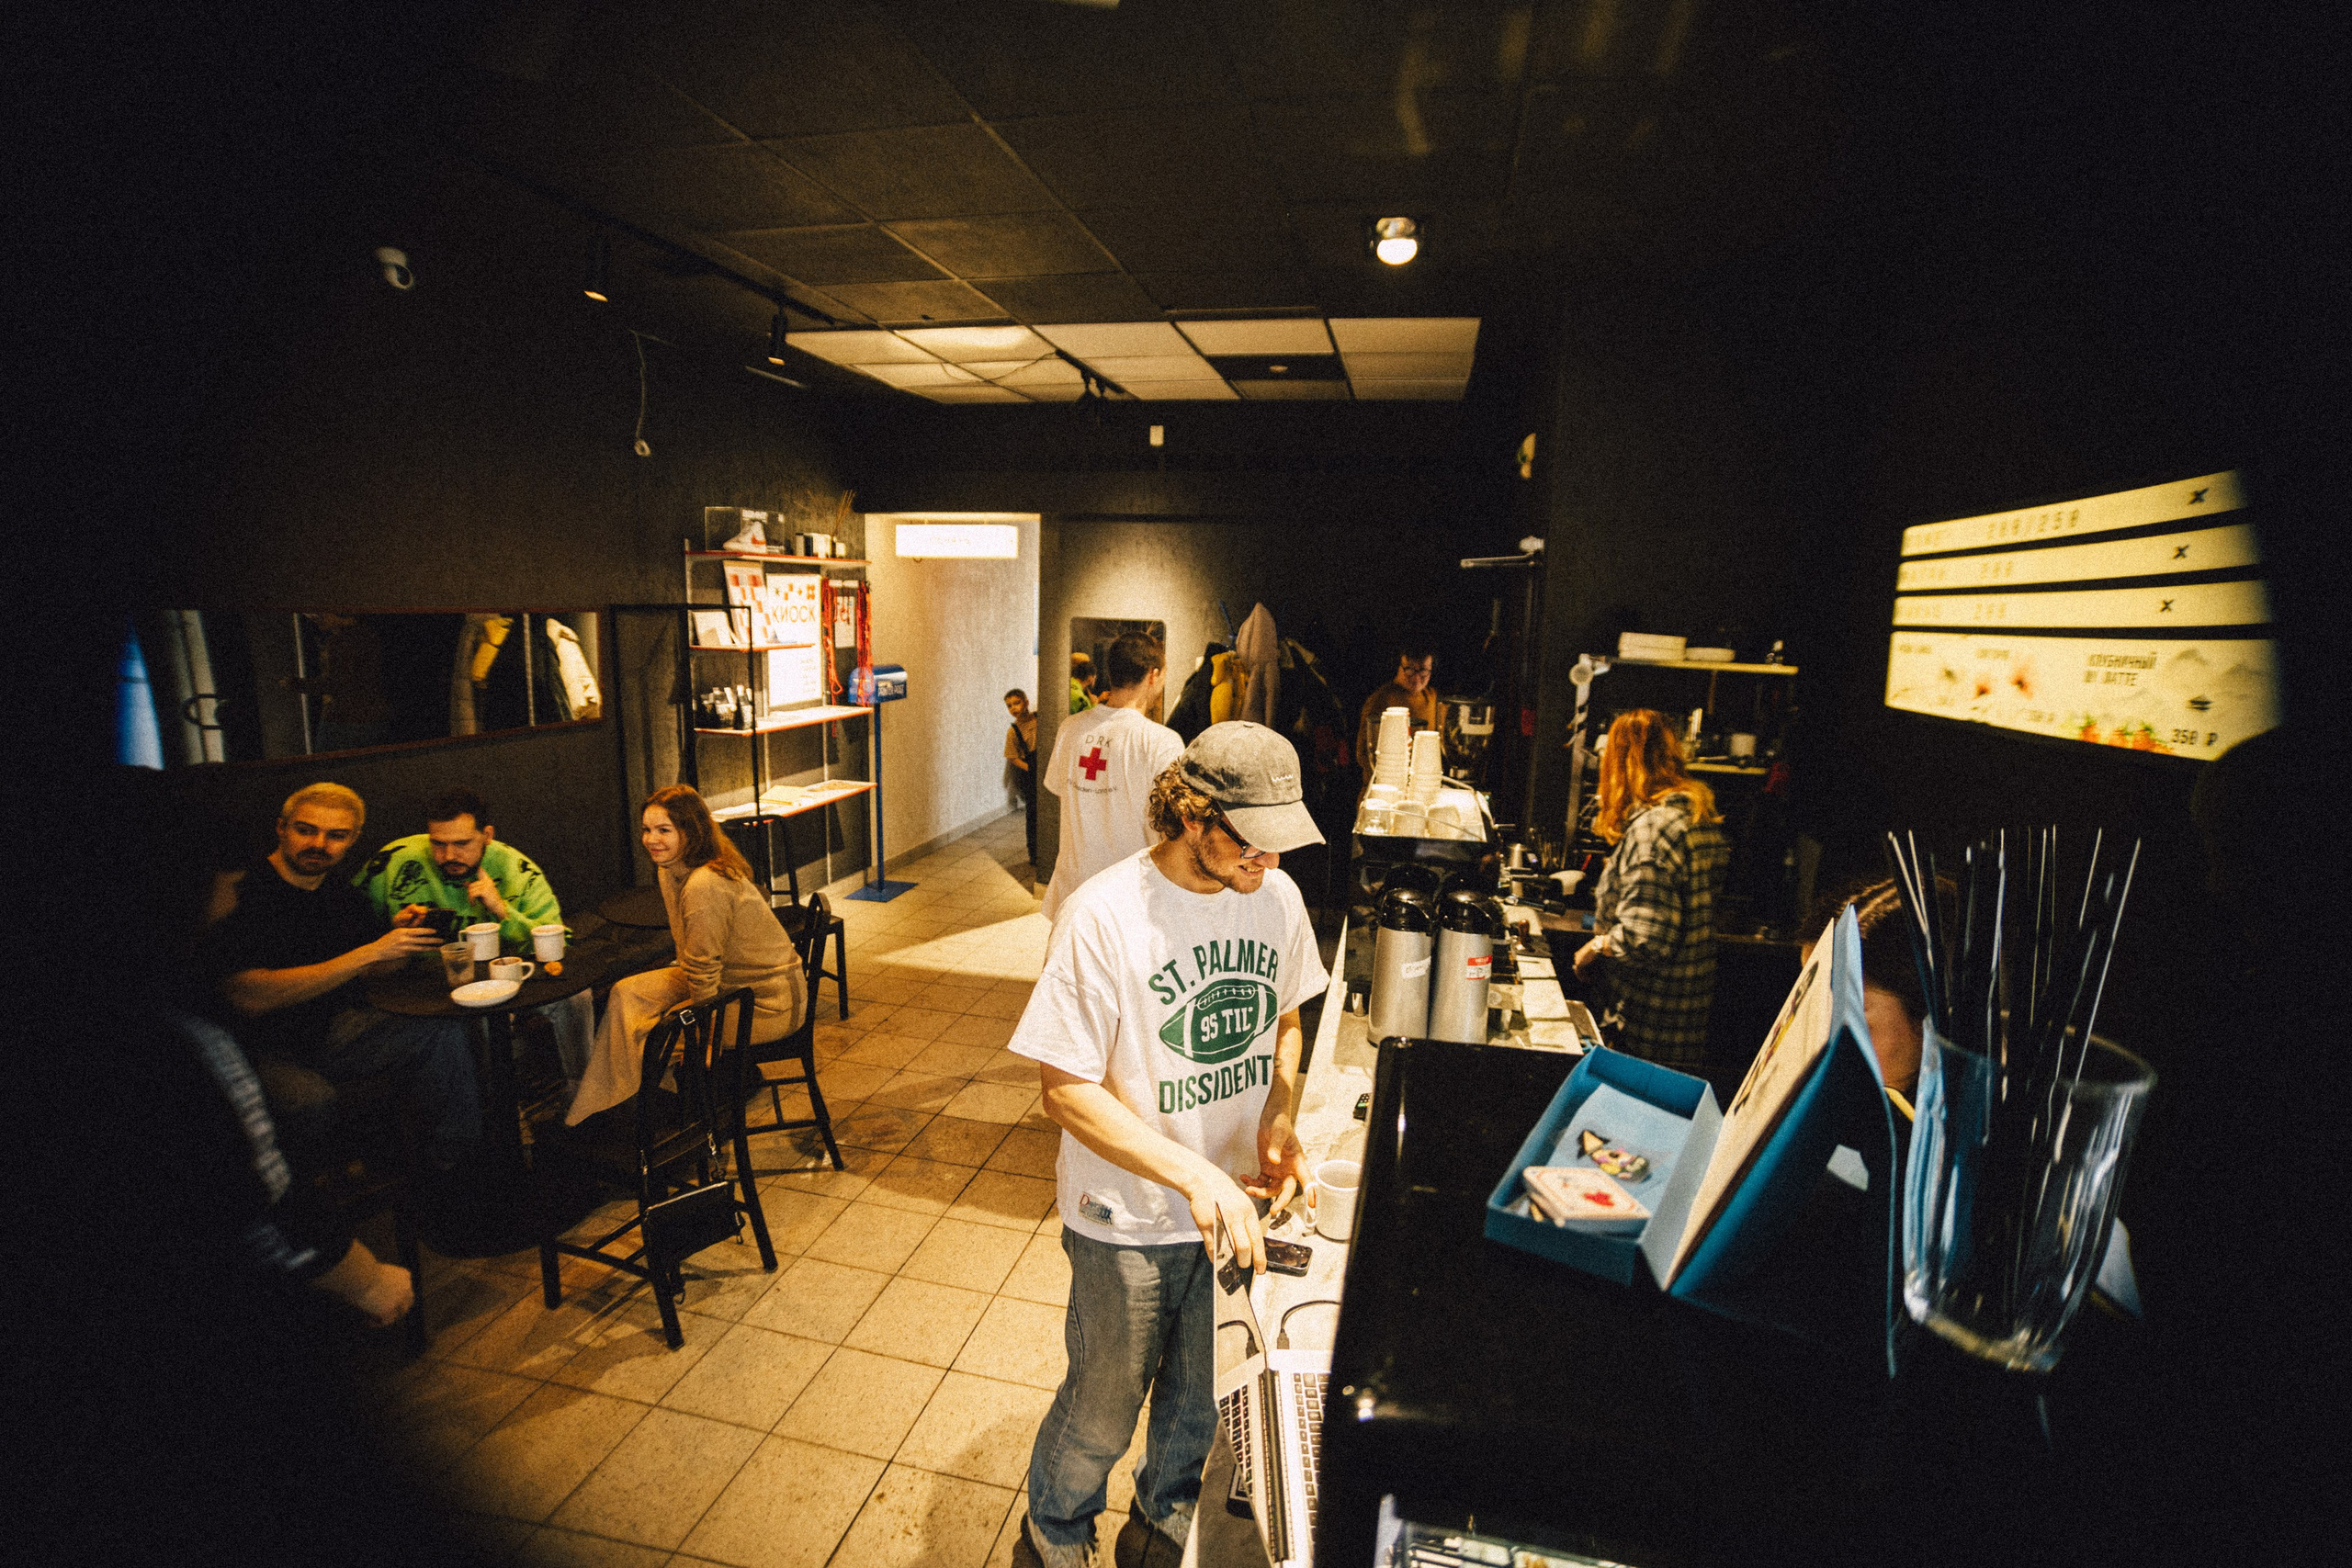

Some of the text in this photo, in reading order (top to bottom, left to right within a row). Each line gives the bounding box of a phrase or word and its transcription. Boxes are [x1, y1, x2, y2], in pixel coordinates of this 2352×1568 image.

[772, 605, 816, 623] КИОСК
[1085, 734, 1114, 748] DRK
[1148, 938, 1278, 1005] ST. PALMER
[1201, 1012, 1218, 1043] 95
[1159, 1055, 1272, 1114] DISSIDENT
